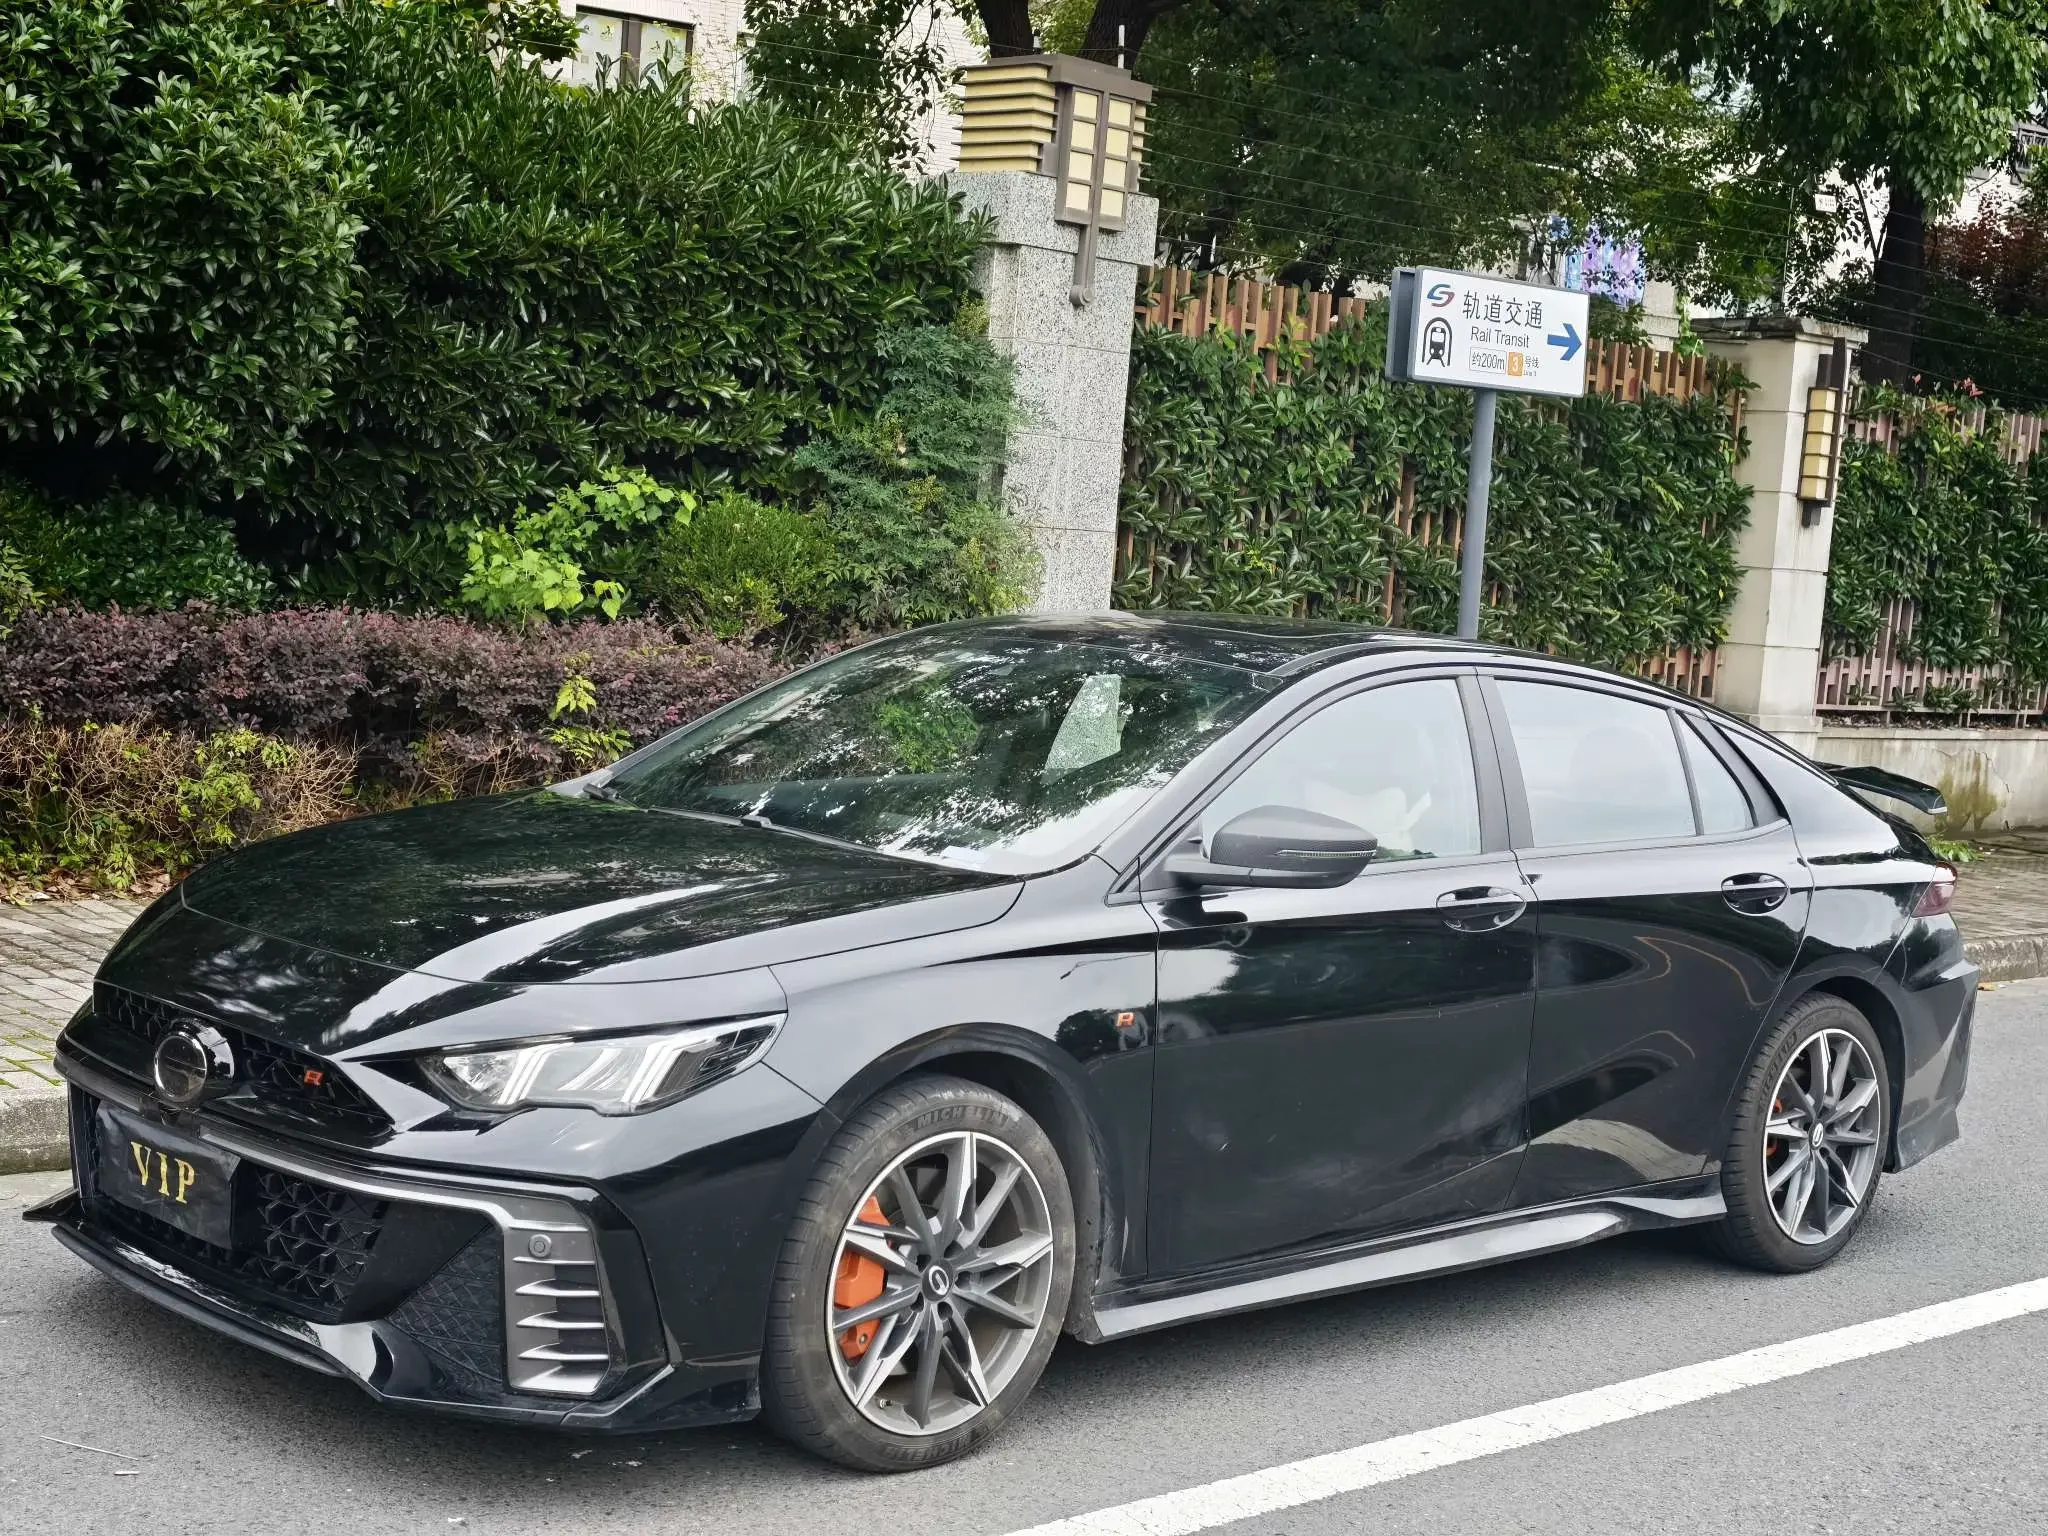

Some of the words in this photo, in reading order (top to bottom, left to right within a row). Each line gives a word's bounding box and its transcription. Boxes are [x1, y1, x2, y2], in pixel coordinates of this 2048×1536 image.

[1462, 290, 1542, 329] 轨道交通
[1470, 326, 1491, 344] Rail
[1495, 329, 1530, 349] Transit
[130, 1141, 195, 1204] VIP
